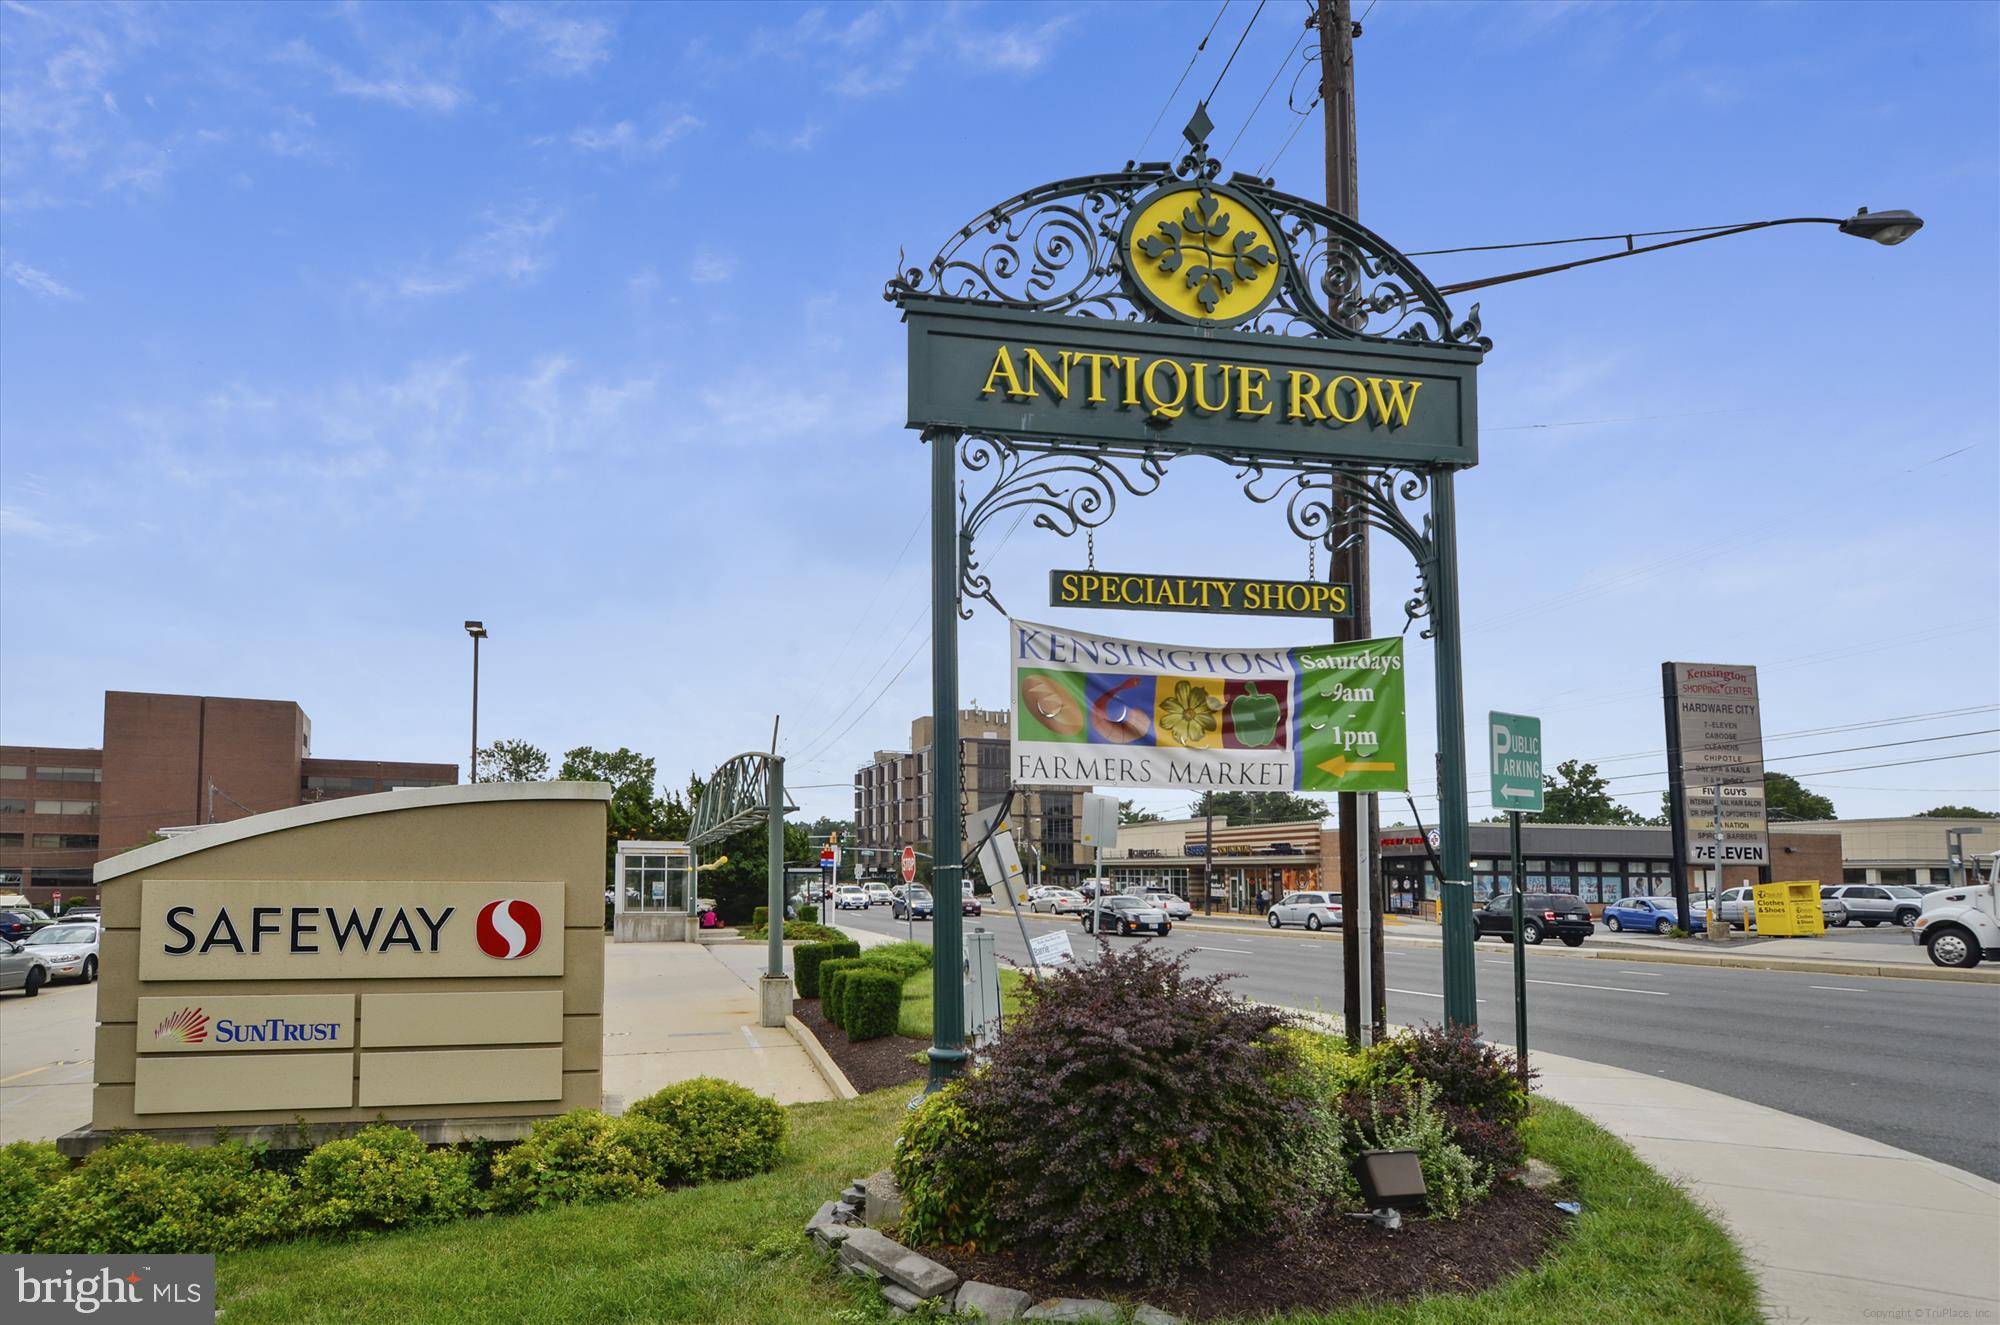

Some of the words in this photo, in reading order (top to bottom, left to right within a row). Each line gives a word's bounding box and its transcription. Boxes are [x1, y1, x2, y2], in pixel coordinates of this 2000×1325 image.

[982, 345, 1273, 420] ANTIQUE
[1287, 370, 1423, 427] ROW
[1060, 573, 1236, 608] SPECIALTY
[1243, 581, 1346, 614] SHOPS
[1017, 628, 1288, 674] KENSINGTON
[1300, 650, 1401, 675] Saturdays
[1686, 667, 1747, 683] Kensington
[1331, 683, 1375, 702] 9am
[1682, 684, 1720, 695] SHOPPING
[1724, 686, 1753, 696] CENTER
[1682, 702, 1734, 714] HARDWARE
[1735, 704, 1755, 715] CITY
[1332, 726, 1378, 751] 1pm
[1704, 732, 1737, 740] CABOOSE
[1704, 754, 1743, 762] CHIPOTLE
[1018, 754, 1151, 783] FARMERS
[1168, 761, 1289, 786] MARKET
[1730, 766, 1751, 774] NAILS
[1702, 787, 1717, 795] FIV
[1724, 788, 1747, 796] GUYS
[902, 857, 915, 871] STOP
[162, 905, 457, 956] SAFEWAY
